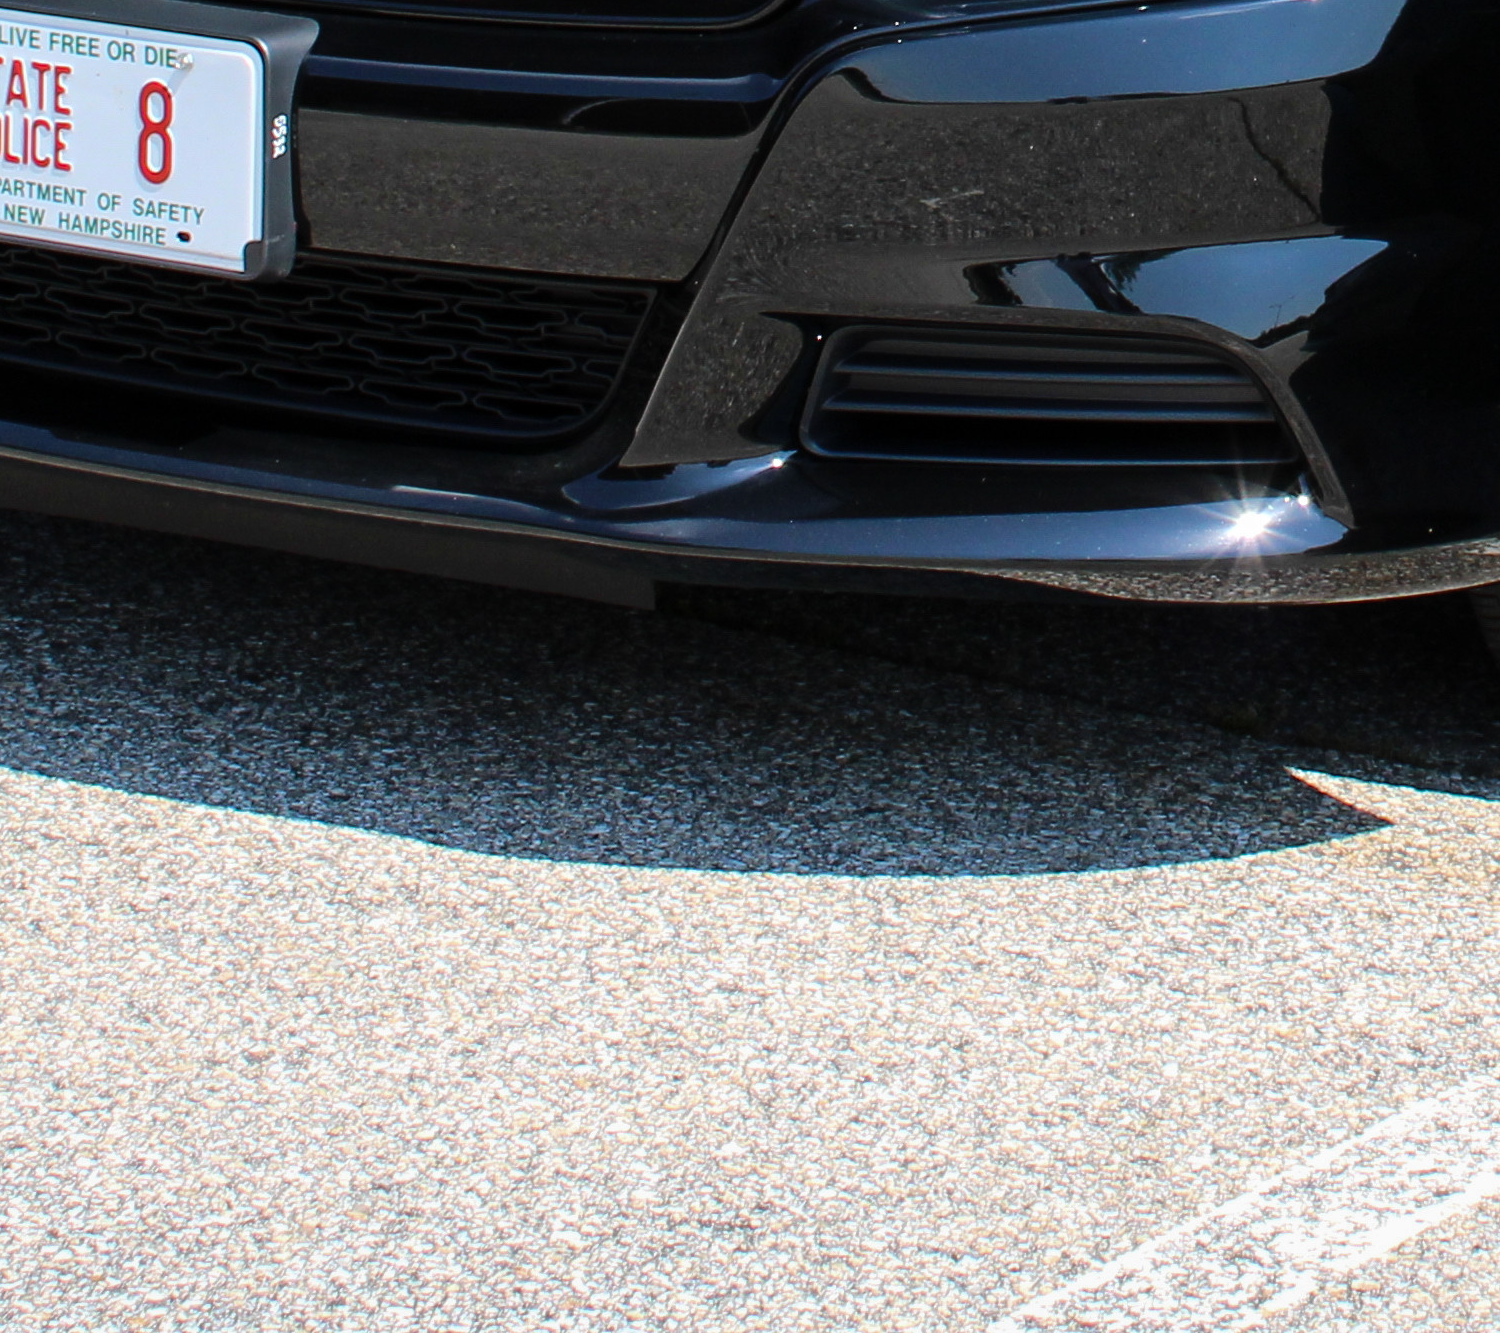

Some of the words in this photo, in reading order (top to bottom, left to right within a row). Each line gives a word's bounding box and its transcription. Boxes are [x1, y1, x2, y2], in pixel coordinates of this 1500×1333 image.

[49, 32, 100, 58] FREE
[106, 39, 136, 63] OR
[144, 45, 179, 69] DIE
[137, 80, 173, 184] 8
[3, 203, 47, 226] NEW
[58, 211, 167, 246] HAMPSHIRE
[97, 192, 122, 213] OF
[132, 197, 205, 225] SAFETY
